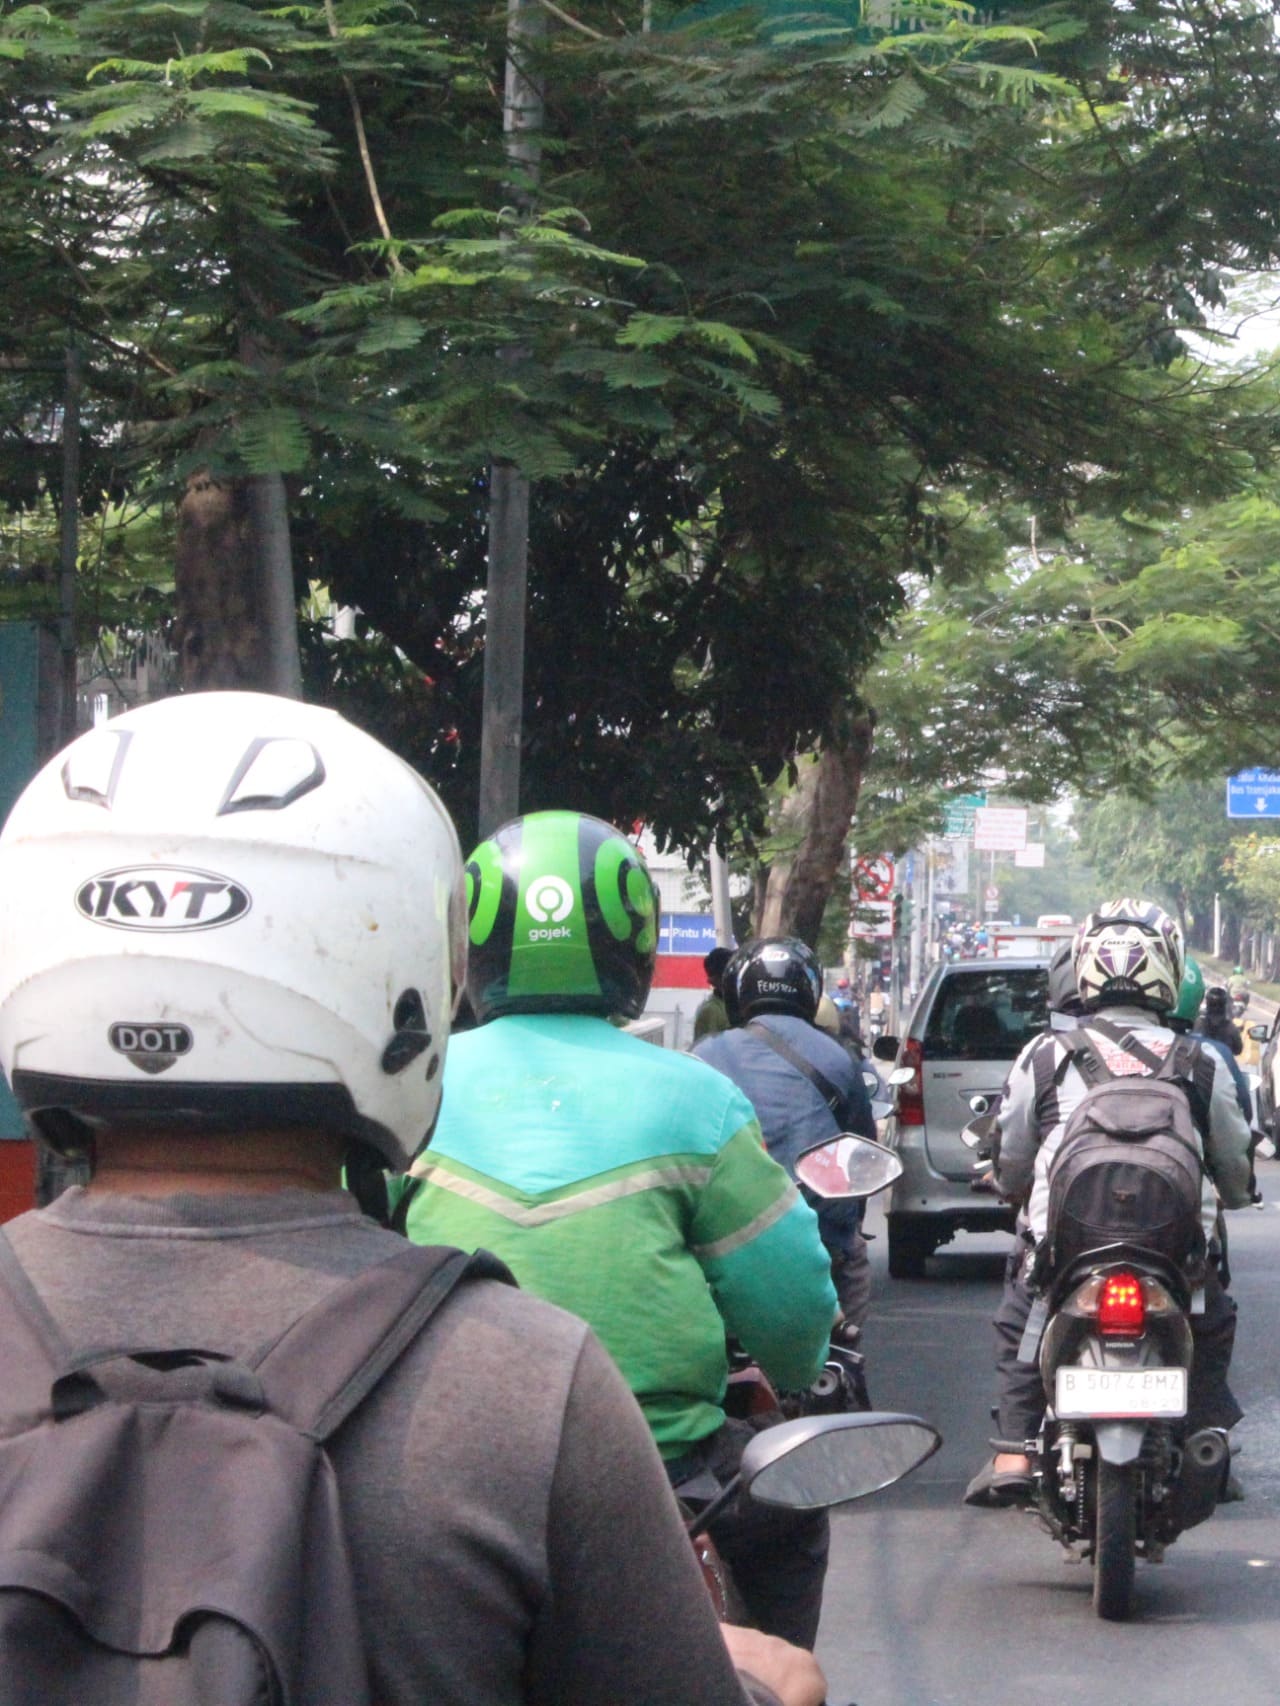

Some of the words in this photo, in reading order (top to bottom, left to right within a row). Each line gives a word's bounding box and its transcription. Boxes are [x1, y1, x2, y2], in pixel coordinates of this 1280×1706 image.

[94, 880, 229, 919] KYT
[528, 926, 572, 942] gojek
[672, 928, 700, 938] Pintu
[118, 1028, 181, 1050] DOT
[1066, 1374, 1076, 1391] B
